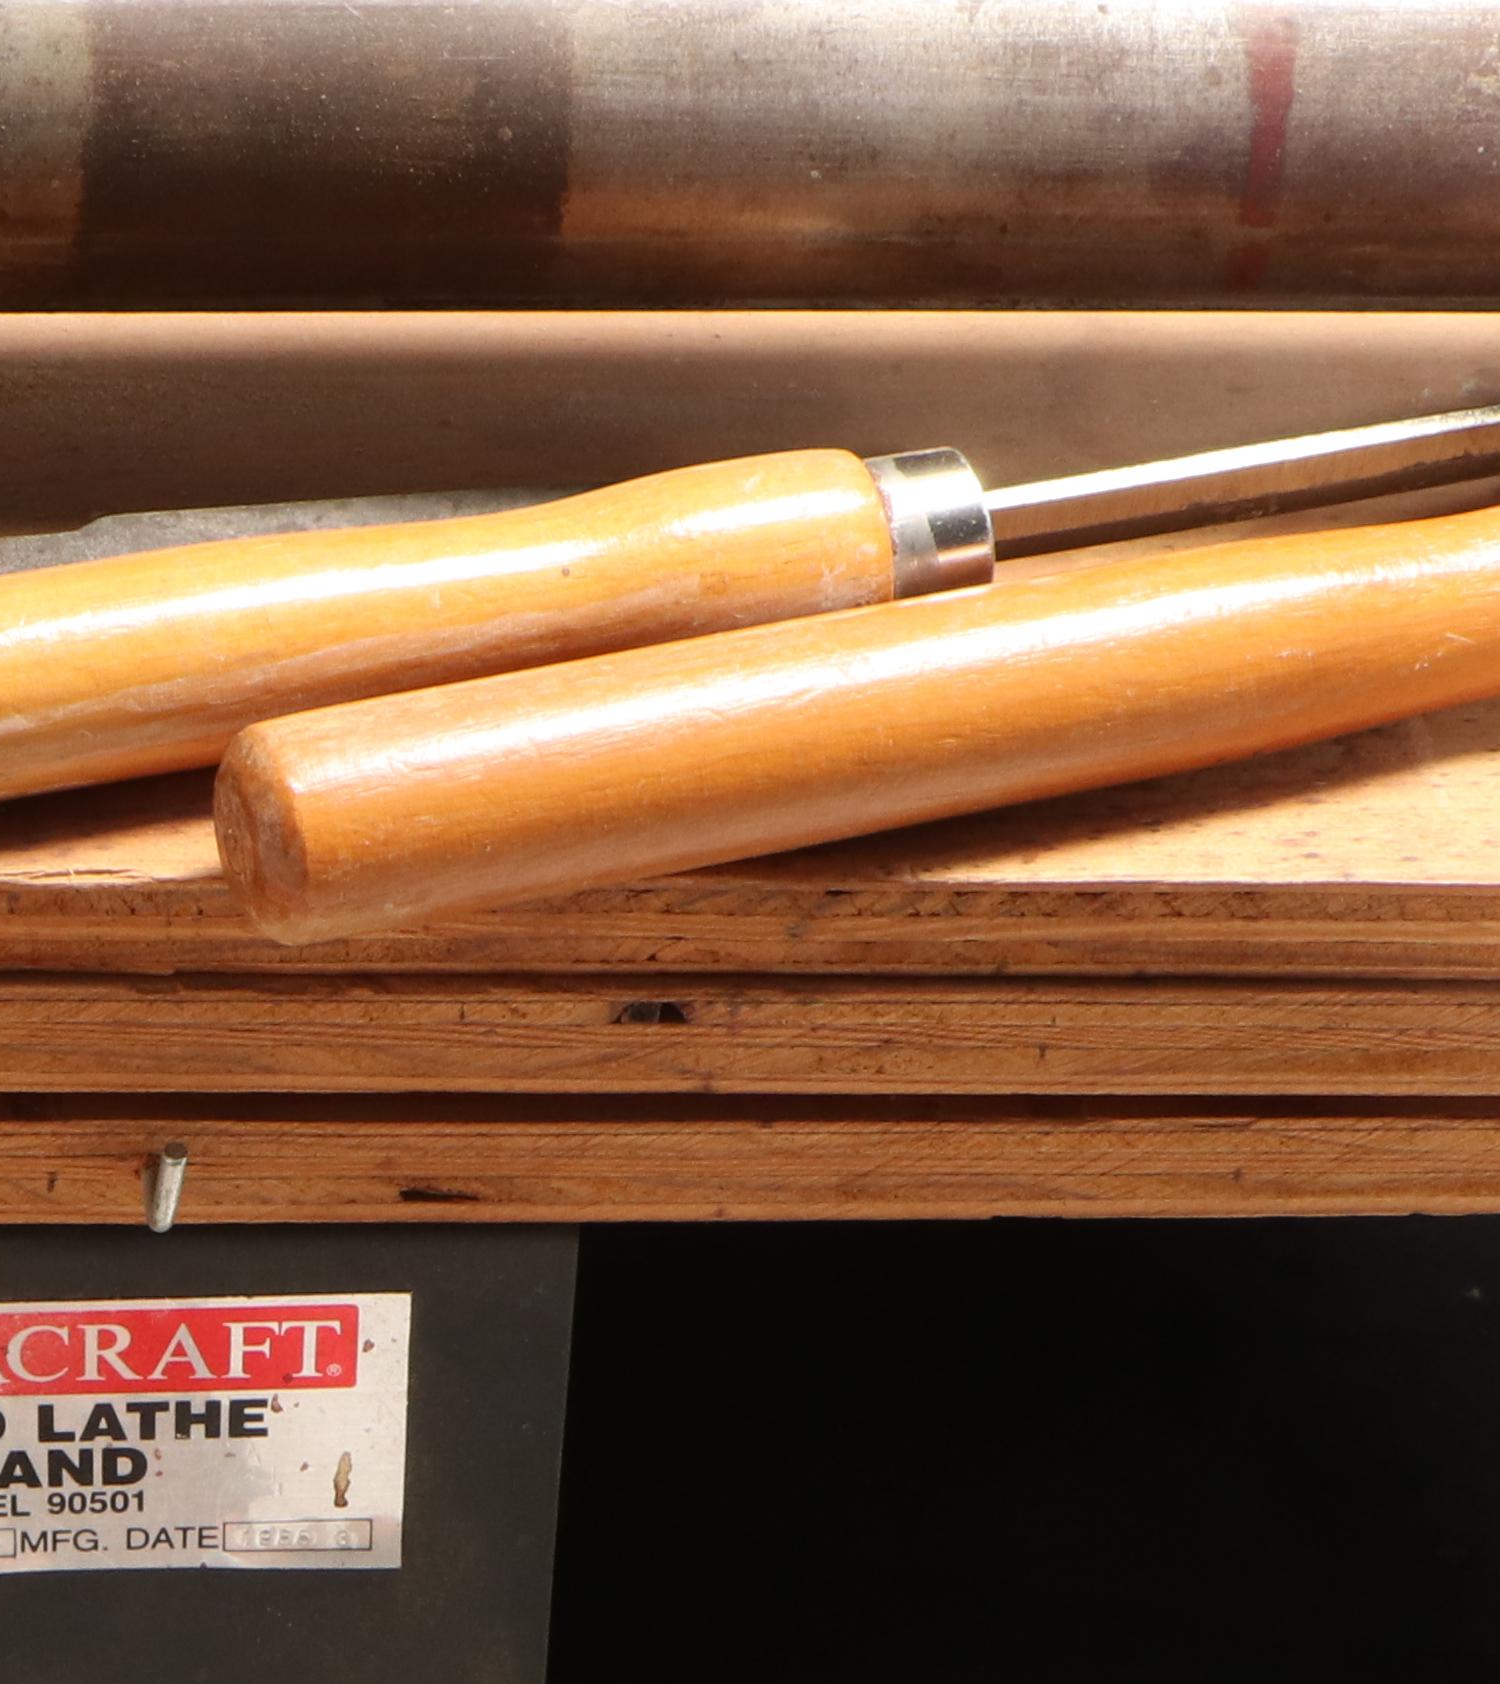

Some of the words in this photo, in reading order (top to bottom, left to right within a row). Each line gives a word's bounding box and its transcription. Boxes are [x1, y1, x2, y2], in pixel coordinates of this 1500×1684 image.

[36, 1398, 270, 1443] LATHE
[47, 1490, 146, 1515] 90501
[19, 1527, 108, 1553] MFG.
[126, 1524, 219, 1550] DATE
